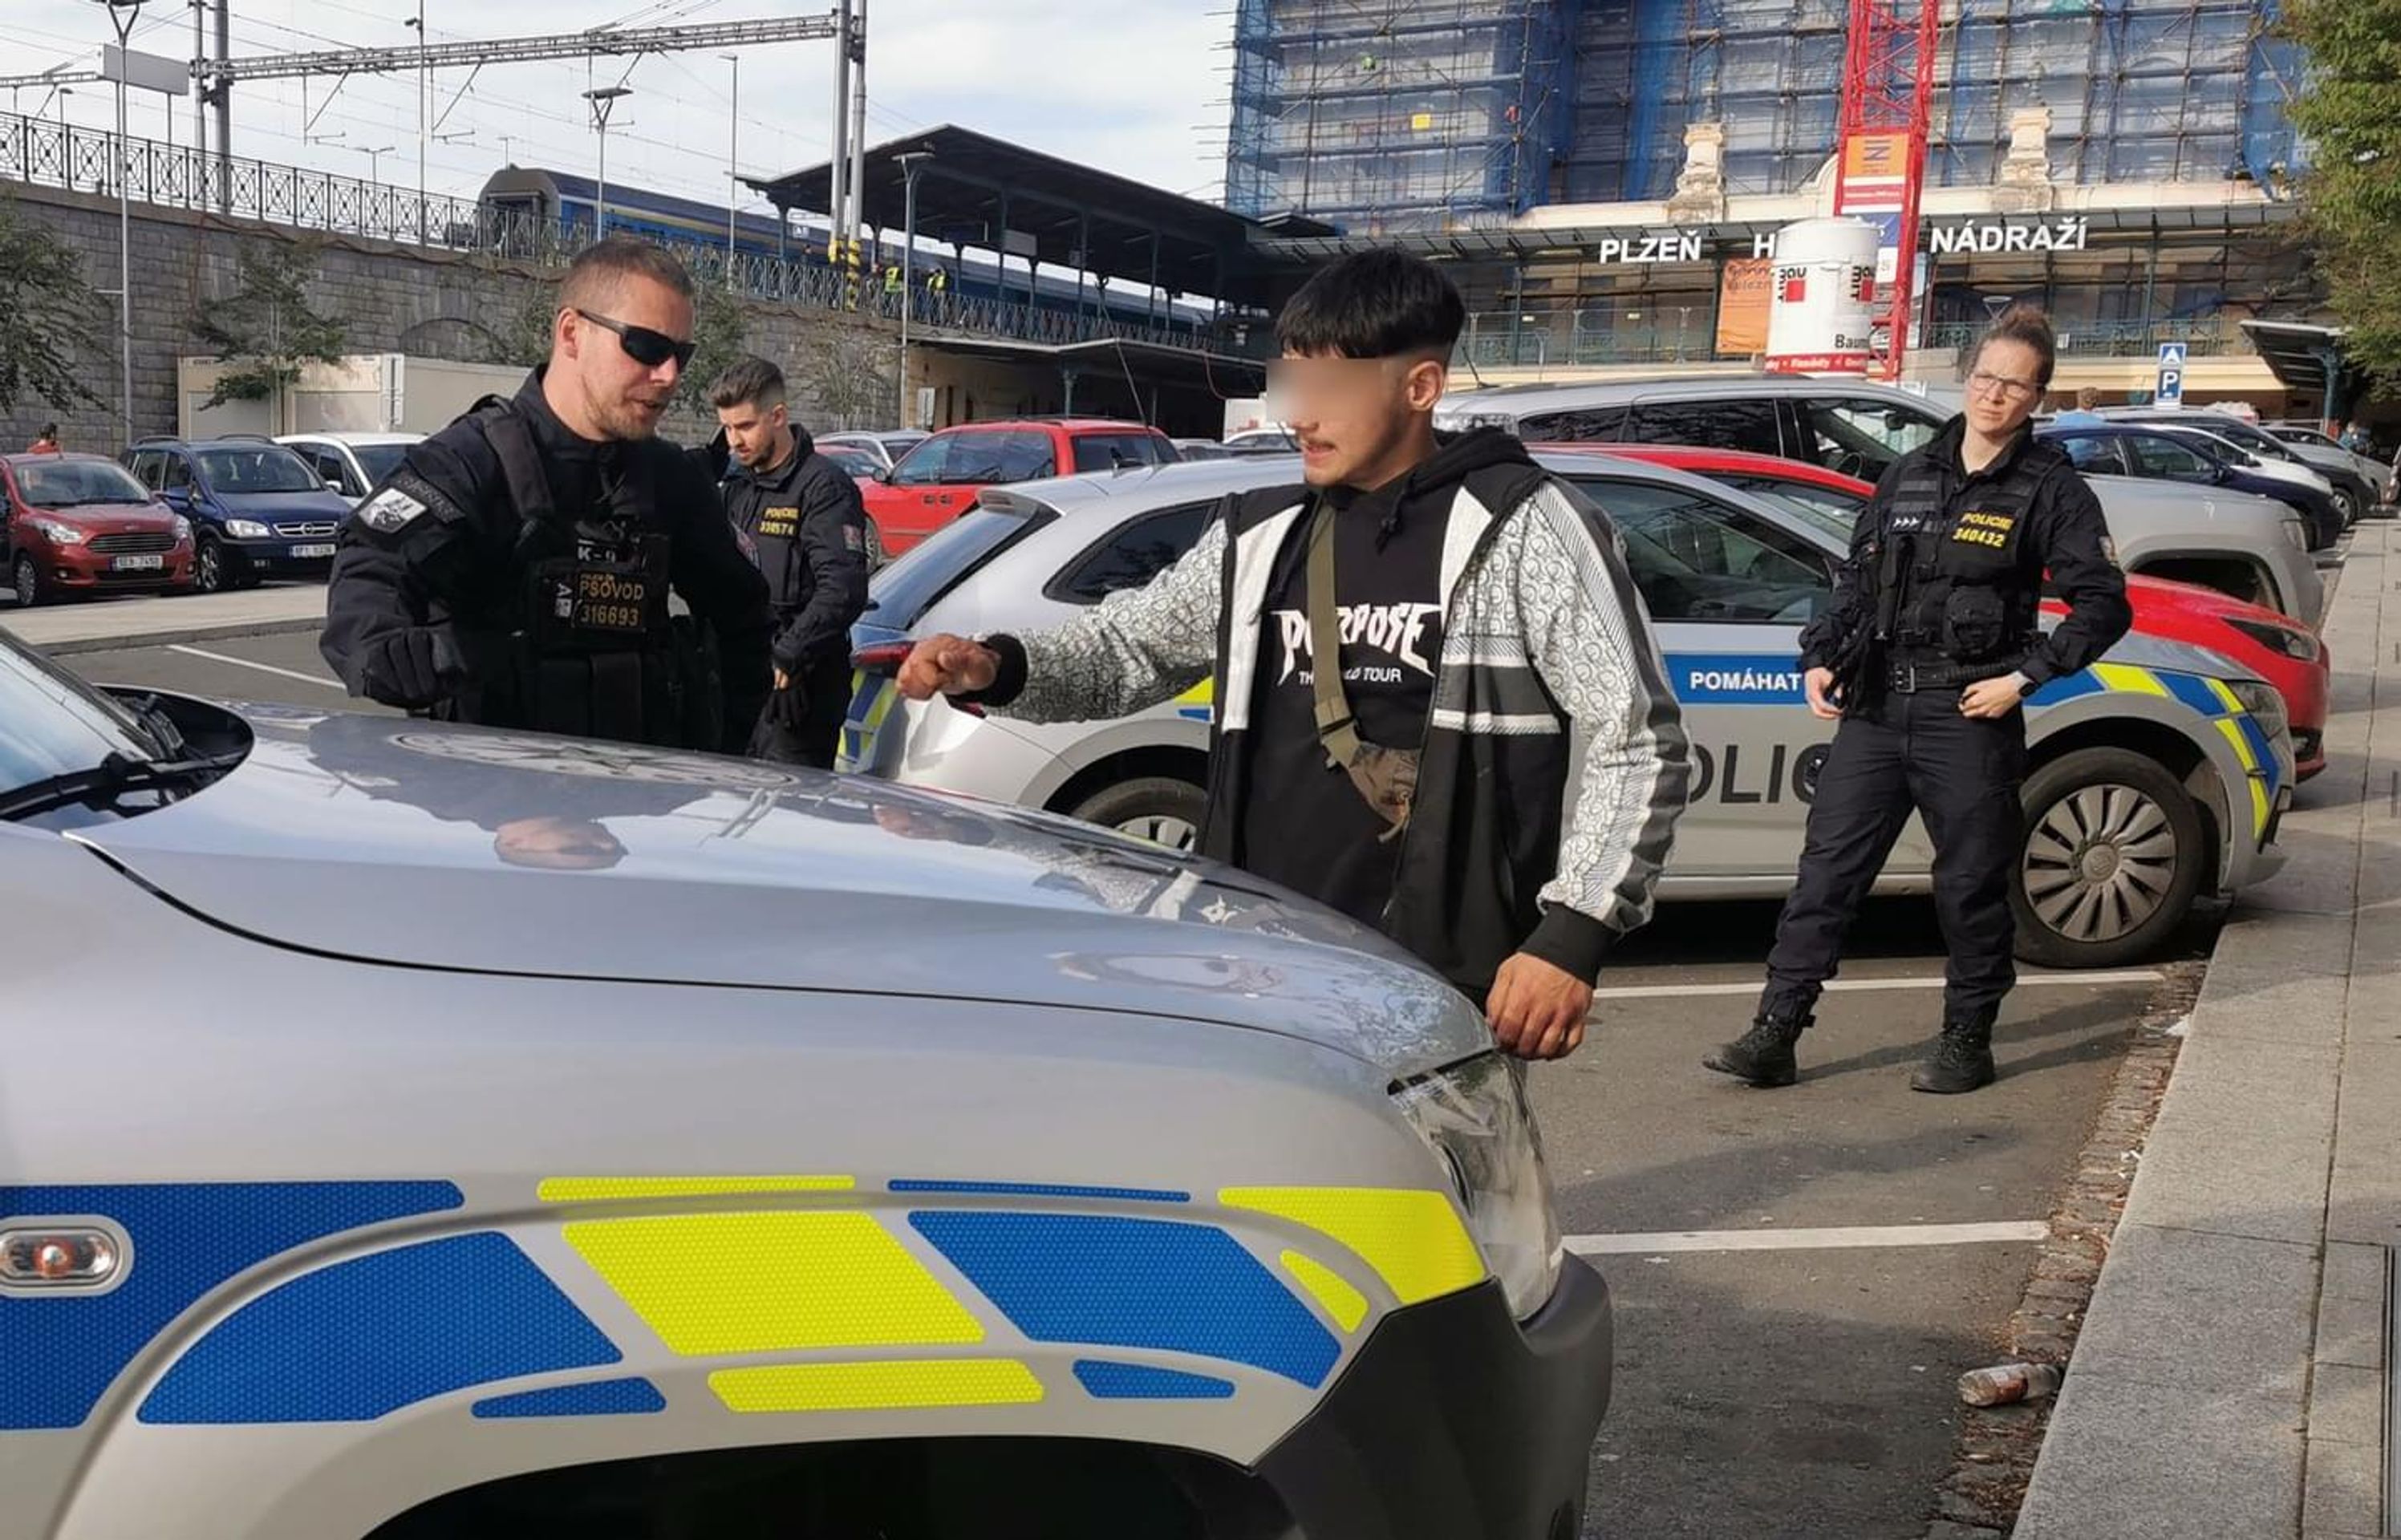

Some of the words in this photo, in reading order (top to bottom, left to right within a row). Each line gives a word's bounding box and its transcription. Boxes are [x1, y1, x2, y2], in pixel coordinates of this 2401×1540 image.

[1600, 230, 1701, 264] PLZEŇ
[1930, 217, 2088, 253] NÁDRAŽÍ
[1961, 513, 2014, 530] POLICIE
[579, 580, 644, 602] PSOVOD
[1298, 671, 1314, 686] TH
[1364, 667, 1403, 683] TOUR
[1689, 667, 1803, 691] POMÁHAT
